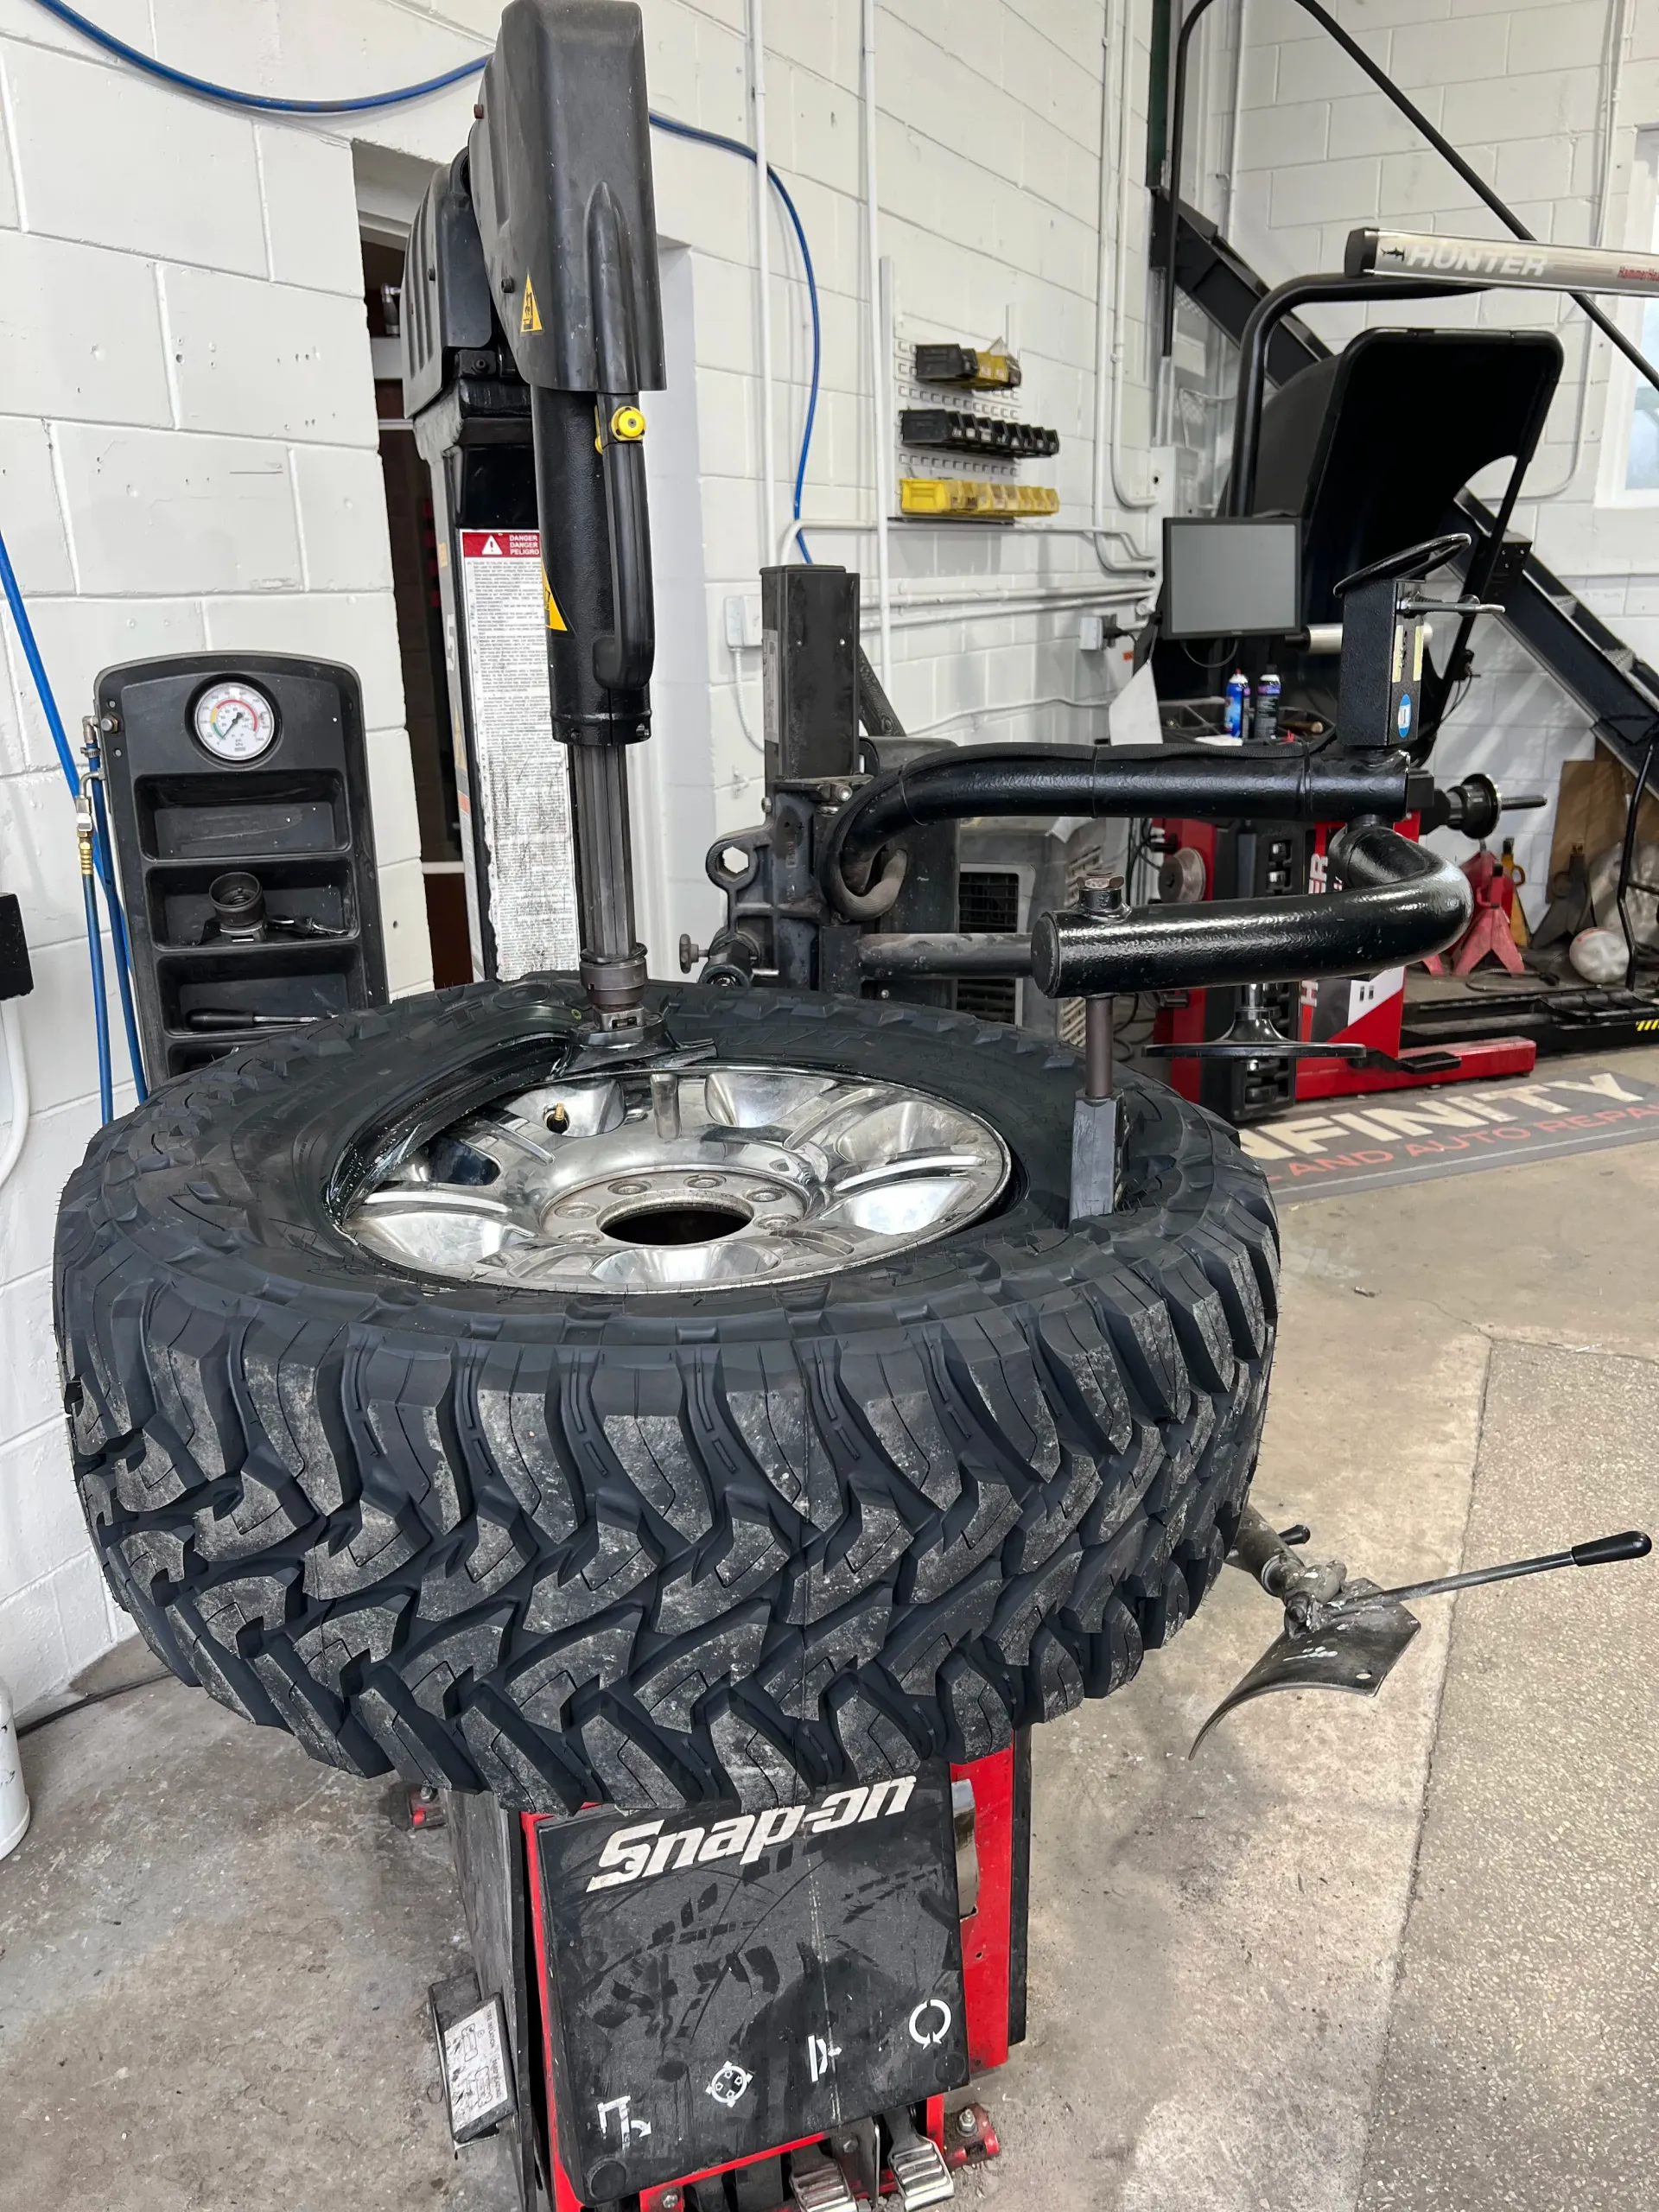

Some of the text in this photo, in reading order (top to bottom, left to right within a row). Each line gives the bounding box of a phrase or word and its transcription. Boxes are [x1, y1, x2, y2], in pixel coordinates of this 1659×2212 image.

[1406, 245, 1548, 276] HUNTER
[1288, 1150, 1394, 1176] AND
[1405, 1127, 1531, 1158] AUTO
[586, 1775, 918, 1893] Snap-on
